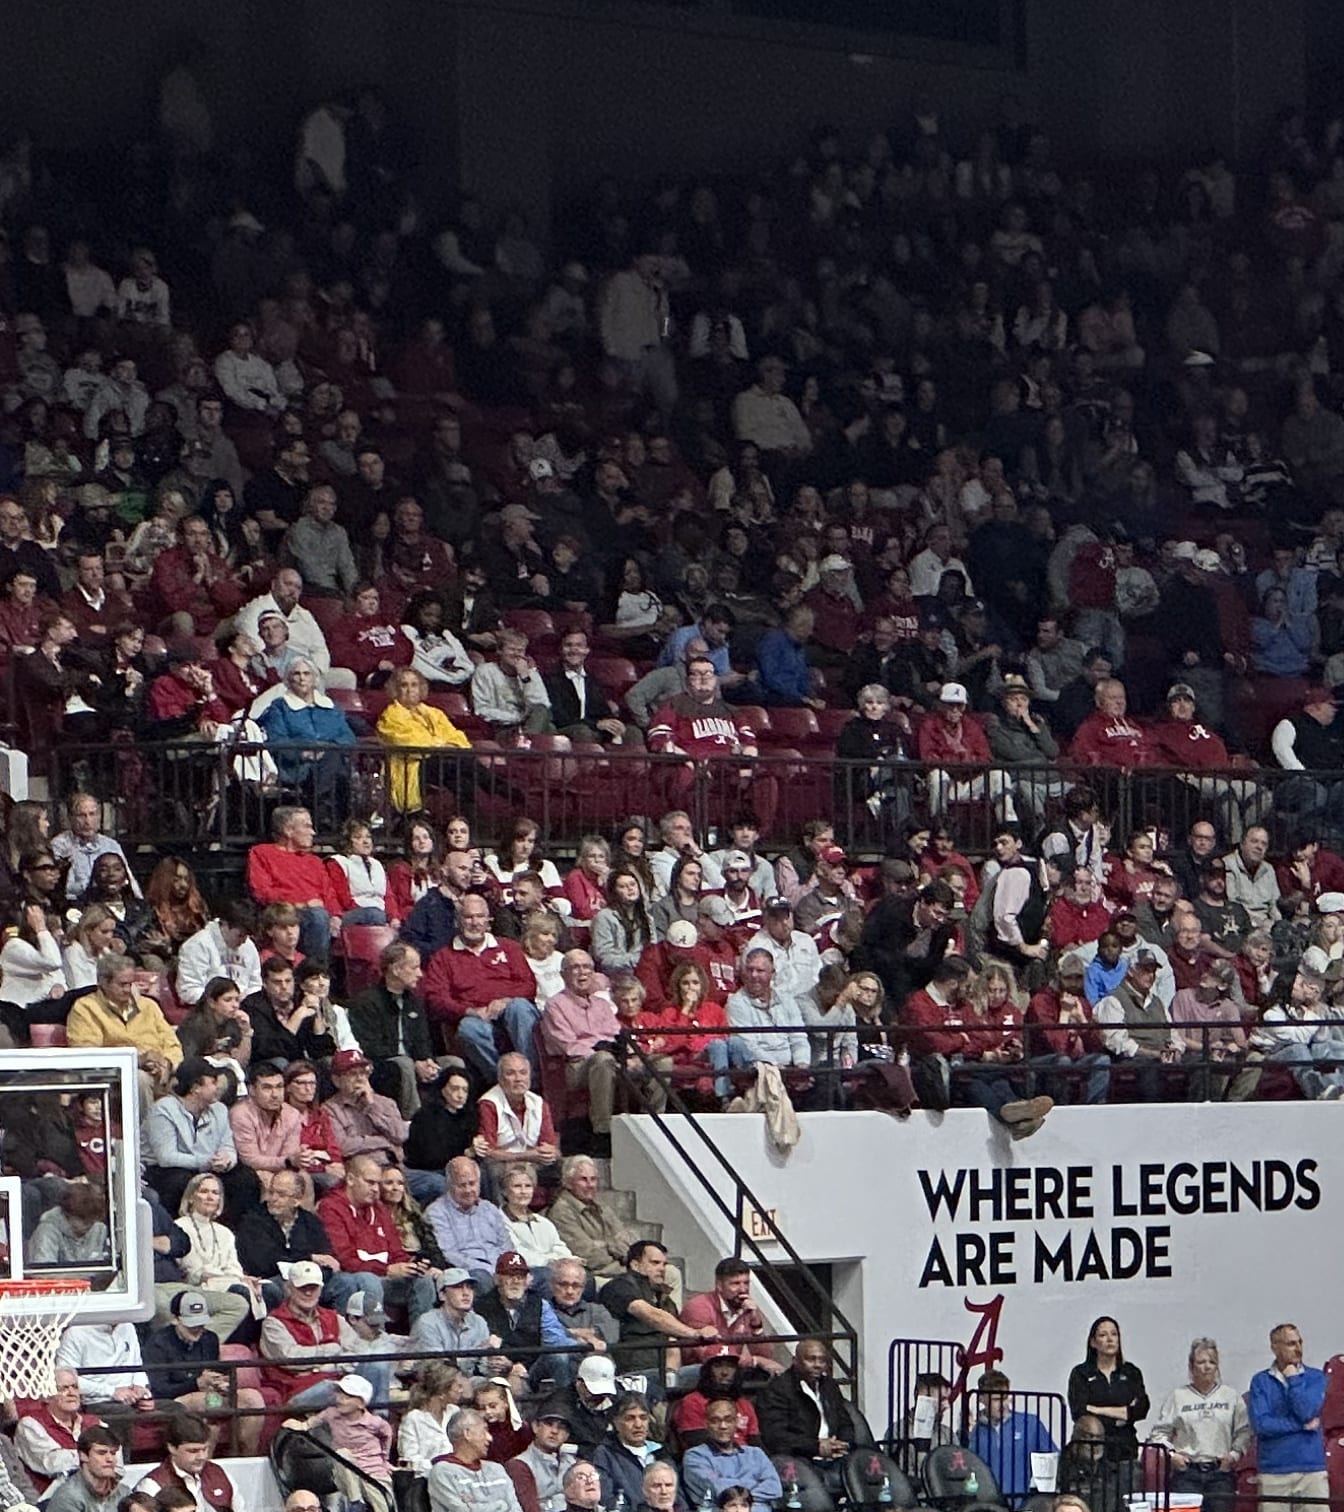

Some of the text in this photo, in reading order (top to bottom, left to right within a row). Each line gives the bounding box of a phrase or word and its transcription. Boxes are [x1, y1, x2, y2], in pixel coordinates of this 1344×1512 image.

[917, 1159, 1321, 1222] WHERE LEGENDS
[918, 1225, 1173, 1289] ARE MADE
